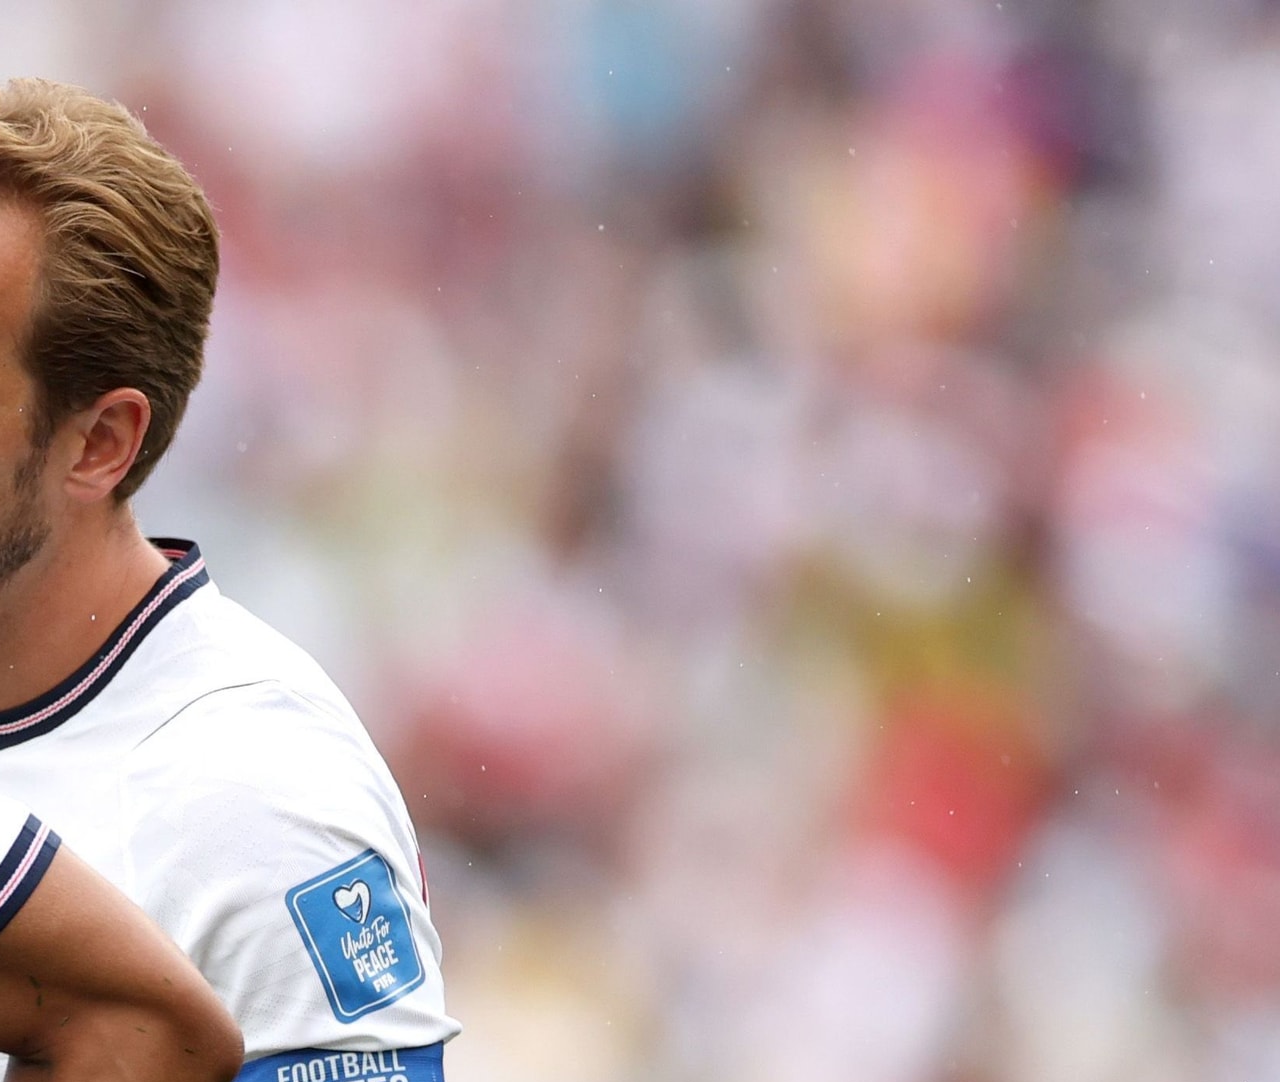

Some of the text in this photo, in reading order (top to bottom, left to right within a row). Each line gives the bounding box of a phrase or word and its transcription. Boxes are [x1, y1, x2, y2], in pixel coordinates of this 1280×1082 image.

[341, 916, 391, 960] Unite For
[353, 941, 399, 983] PEACE
[373, 972, 396, 993] FIFA
